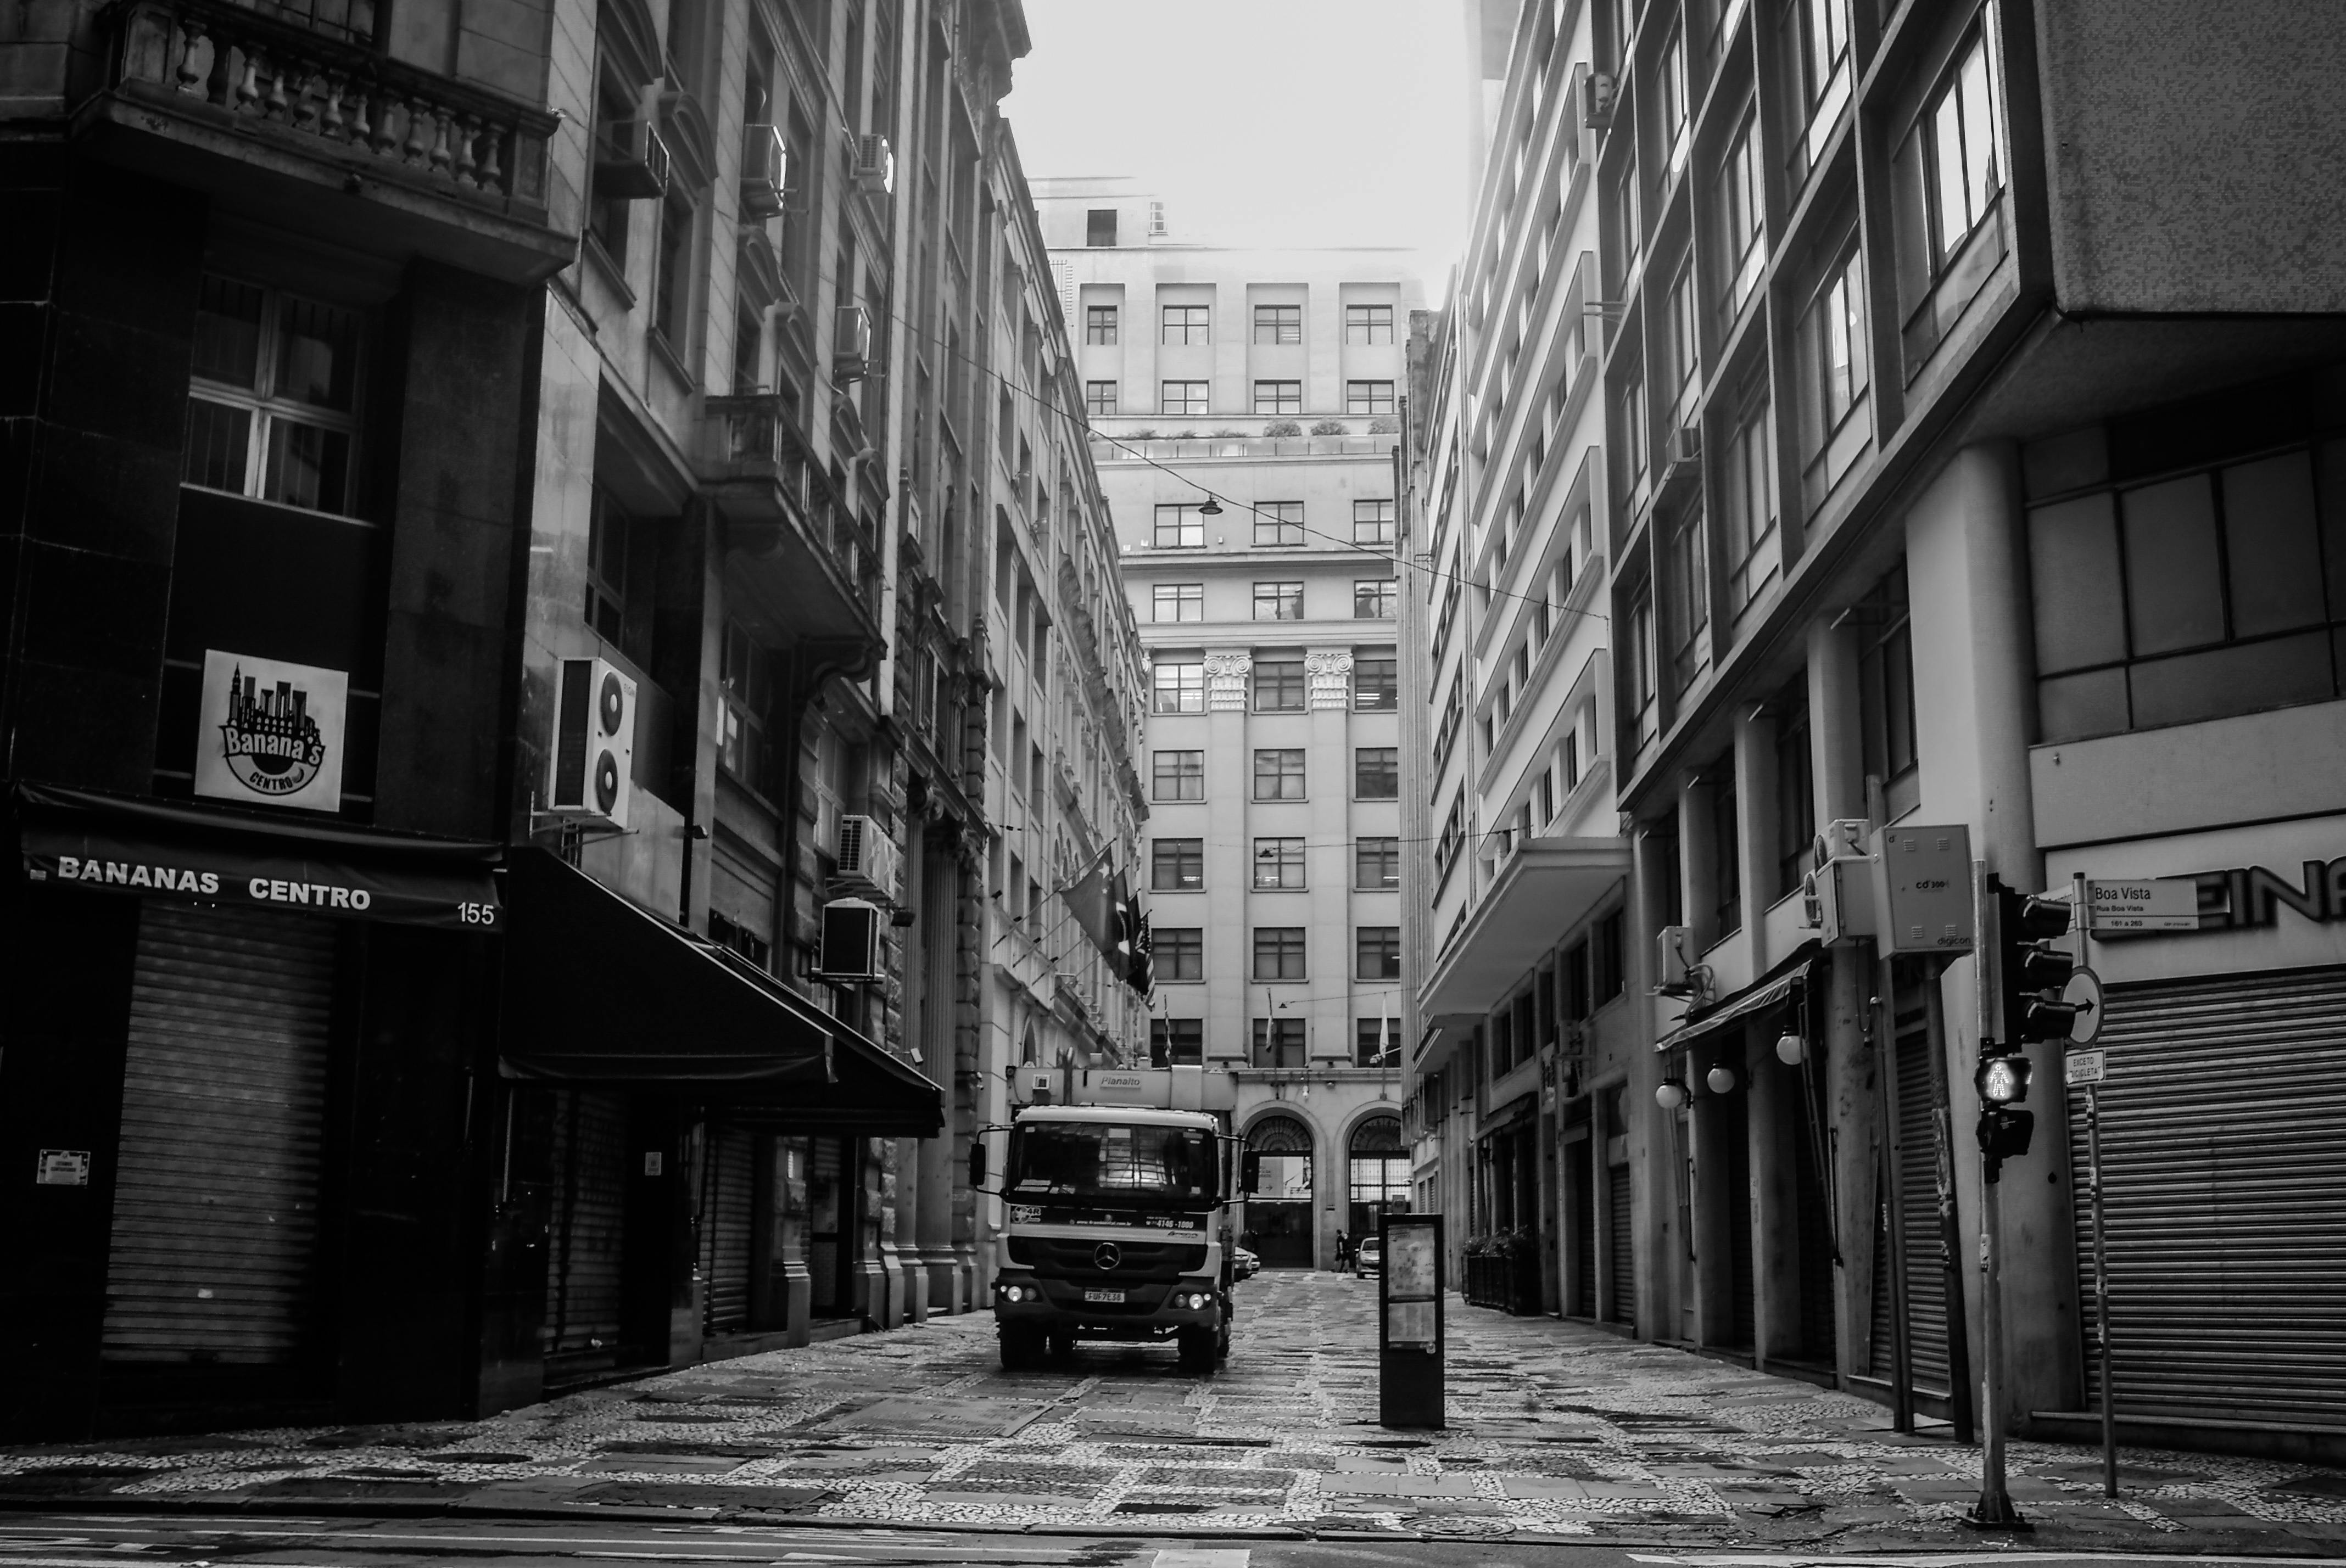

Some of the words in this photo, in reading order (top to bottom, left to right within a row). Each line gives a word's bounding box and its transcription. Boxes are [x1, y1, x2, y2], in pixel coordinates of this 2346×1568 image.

[226, 727, 322, 765] Banana's
[249, 771, 293, 790] CENTRO
[58, 856, 219, 894] BANANAS
[249, 878, 371, 910] CENTRO
[457, 902, 494, 925] 155
[2095, 887, 2118, 900] Boa
[2121, 887, 2151, 900] Vista
[1937, 937, 1971, 946] digicon
[1101, 1077, 1140, 1085] Planalto
